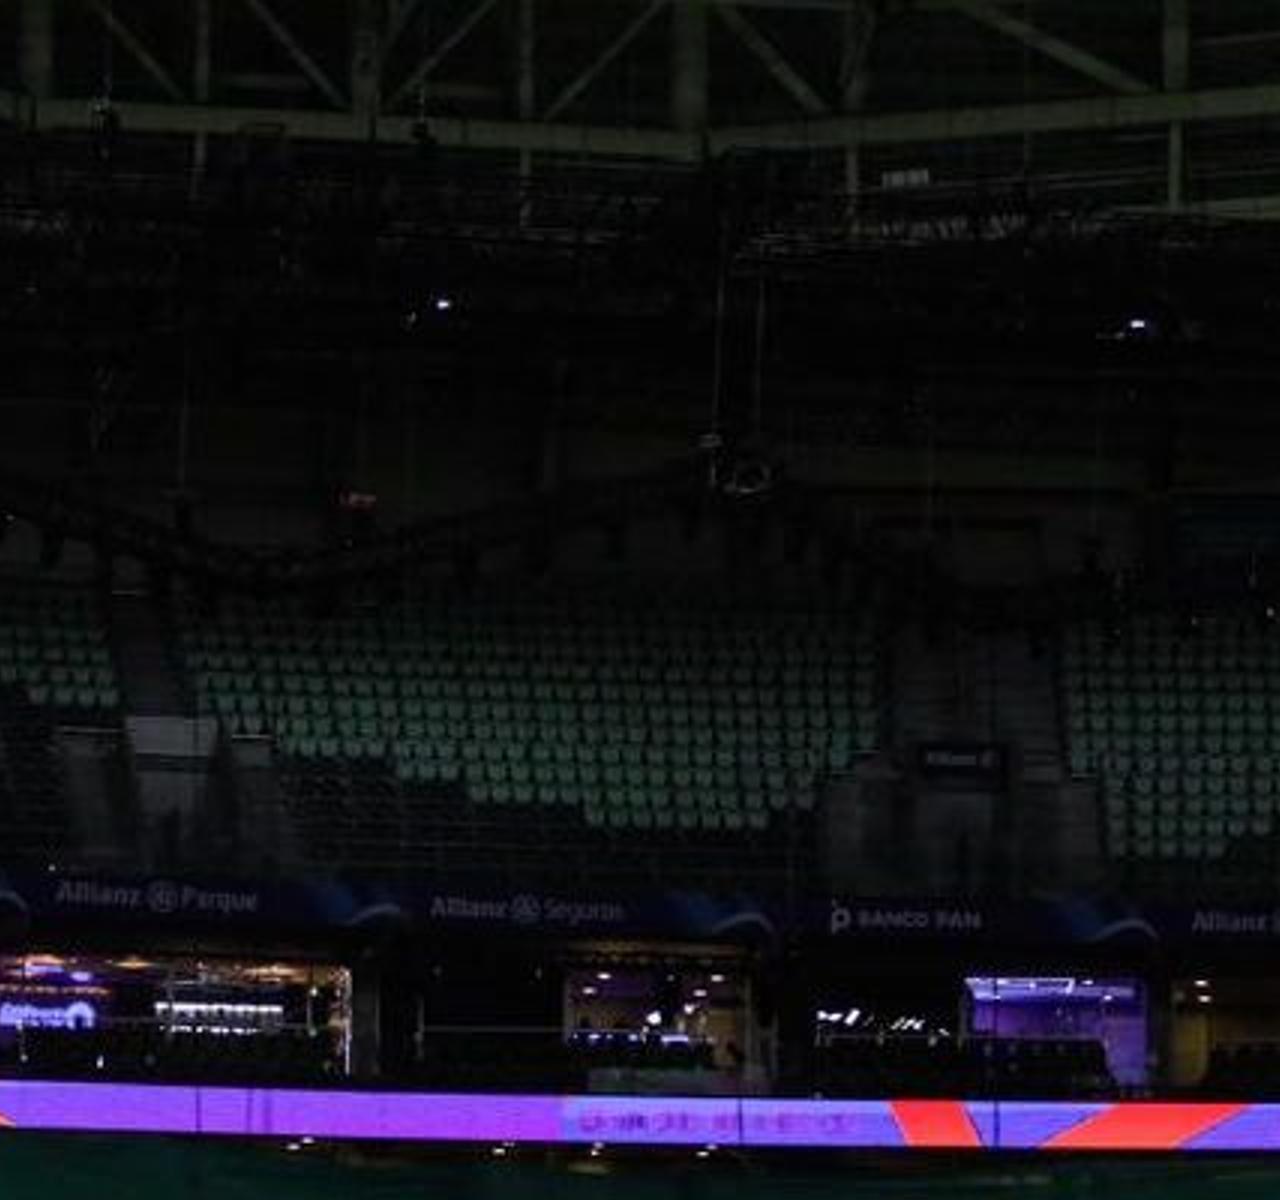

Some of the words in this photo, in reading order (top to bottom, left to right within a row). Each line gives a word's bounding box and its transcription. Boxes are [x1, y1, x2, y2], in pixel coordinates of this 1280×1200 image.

[56, 881, 143, 910] Allianz
[182, 884, 259, 914] Parque
[857, 910, 929, 929] BANCO
[935, 910, 985, 929] PAN
